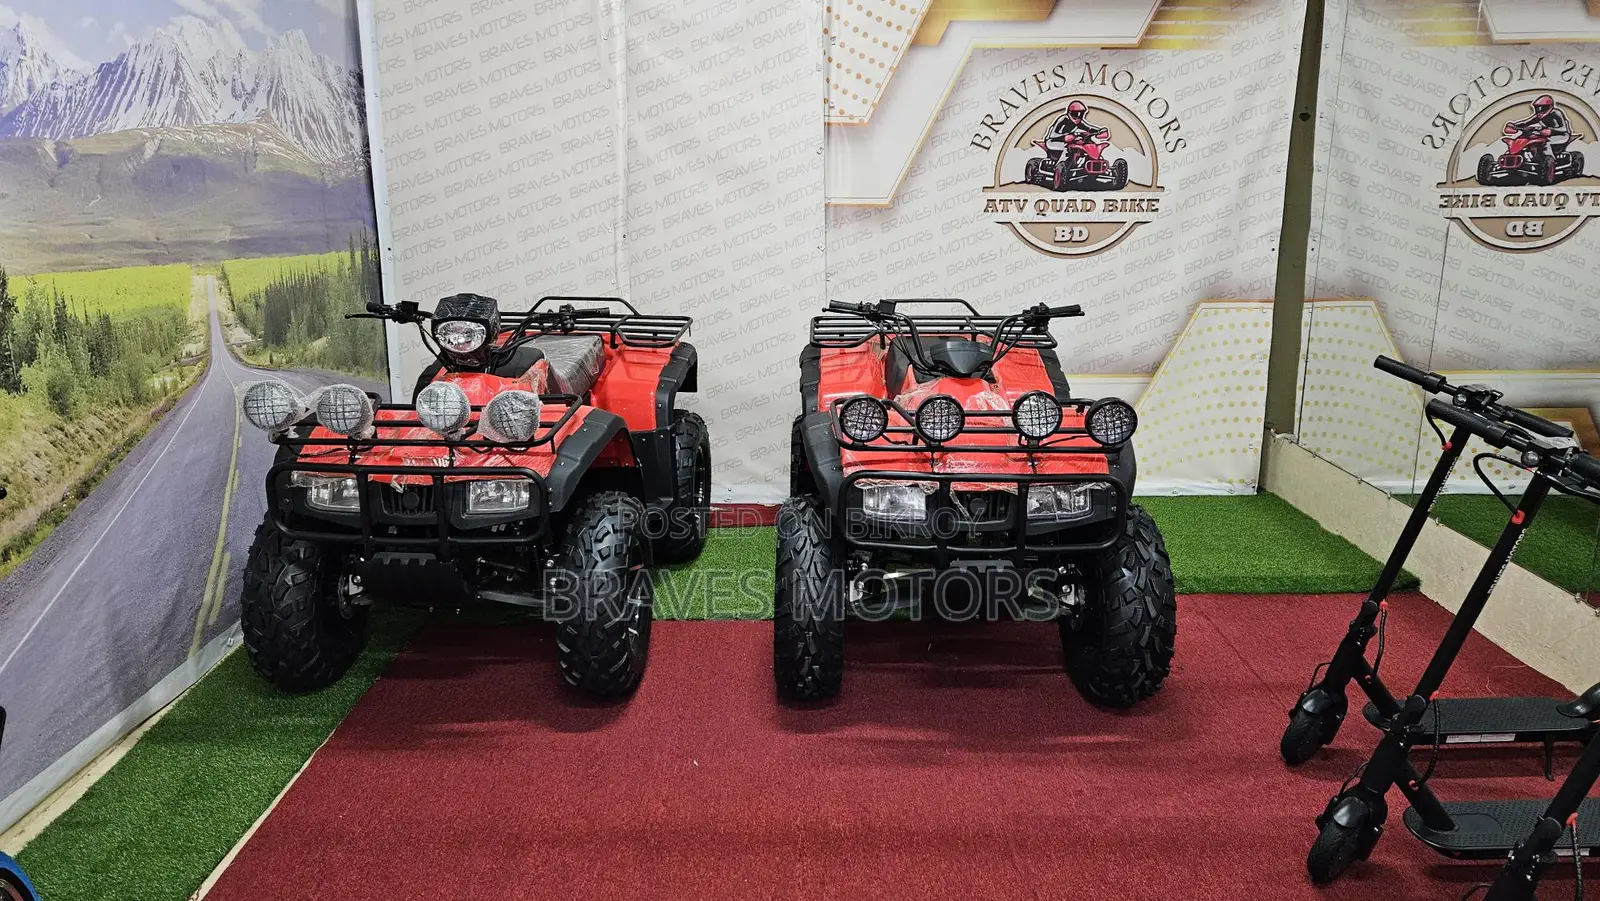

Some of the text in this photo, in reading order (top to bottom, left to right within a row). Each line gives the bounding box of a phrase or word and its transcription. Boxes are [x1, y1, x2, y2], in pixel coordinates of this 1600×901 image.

[405, 10, 462, 40] MOTORS
[413, 32, 468, 61] BRAVES
[470, 9, 527, 40] MOTORS
[479, 13, 593, 64] BRAVES MOTORS
[627, 1, 737, 51] BRAVES MOTORS
[690, 1, 801, 52] BRAVES MOTORS
[753, 19, 806, 49] BRAVES
[543, 35, 597, 63] BRAVES
[1231, 27, 1284, 57] BRAVES
[415, 57, 472, 86] MOTORS
[628, 47, 684, 76] MOTORS
[636, 45, 746, 98] BRAVES MOTORS
[699, 44, 809, 97] BRAVES MOTORS
[981, 51, 1038, 82] MOTORS
[1167, 51, 1224, 79] MOTORS
[1174, 51, 1285, 102] BRAVES MOTORS
[424, 58, 536, 108] BRAVES MOTORS
[488, 59, 601, 109] BRAVES MOTORS
[552, 80, 605, 109] BRAVES
[761, 65, 814, 95] BRAVES
[1234, 73, 1287, 101] BRAVES
[425, 104, 481, 134] MOTORS
[638, 92, 692, 122] MOTORS
[645, 90, 754, 140] BRAVES MOTORS
[707, 89, 816, 141] BRAVES MOTORS
[970, 62, 1187, 153] BRAVES MOTORS
[1231, 95, 1286, 127] MOTORS
[434, 103, 545, 154] BRAVES MOTORS
[499, 105, 609, 154] BRAVES MOTORS
[561, 126, 614, 154] BRAVES
[768, 111, 821, 139] BRAVES
[435, 149, 491, 180] MOTORS
[646, 137, 700, 166] MOTORS
[654, 158, 705, 186] BRAVES
[707, 135, 761, 165] MOTORS
[1172, 143, 1228, 170] MOTORS
[1179, 142, 1287, 190] BRAVES MOTORS
[444, 149, 553, 198] BRAVES MOTORS
[507, 172, 560, 200] BRAVES
[562, 149, 616, 180] MOTORS
[570, 172, 621, 199] BRAVES
[716, 157, 768, 186] BRAVES
[936, 164, 988, 192] BRAVES
[655, 181, 708, 211] MOTORS
[662, 178, 770, 230] BRAVES MOTORS
[983, 198, 1160, 216] ATV QUAD BIKE
[1176, 184, 1231, 213] MOTORS
[391, 194, 500, 242] BRAVES MOTORS
[453, 193, 562, 242] BRAVES MOTORS
[516, 216, 569, 243] BRAVES
[724, 201, 775, 229] BRAVES
[880, 207, 931, 233] BRAVES
[1181, 206, 1233, 233] BRAVES
[664, 224, 717, 253] MOTORS
[671, 222, 777, 272] BRAVES MOTORS
[880, 229, 933, 259] MOTORS
[1053, 226, 1090, 242] BD
[1120, 228, 1174, 256] MOTORS
[393, 237, 446, 264] MOTORS
[402, 238, 508, 286] BRAVES MOTORS
[463, 237, 570, 283] BRAVES MOTORS
[732, 245, 783, 273] BRAVES
[886, 228, 993, 275] BRAVES MOTORS
[946, 250, 997, 277] BRAVES
[1124, 227, 1231, 275] BRAVES MOTORS
[1184, 250, 1234, 275] BRAVES
[525, 259, 576, 286] BRAVES
[672, 267, 725, 297] MOTORS
[885, 271, 939, 299] MOTORS
[943, 270, 998, 298] MOTORS
[1003, 272, 1059, 300] MOTORS
[1063, 270, 1117, 301] MOTORS
[1123, 270, 1176, 297] MOTORS
[680, 265, 784, 314] BRAVES MOTORS
[740, 288, 790, 314] BRAVES
[1128, 290, 1178, 315] BRAVES
[1181, 268, 1233, 296] MOTORS
[739, 307, 792, 337] MOTORS
[1126, 311, 1179, 338] MOTORS
[743, 331, 796, 359] MOTORS
[706, 374, 755, 400] BRAVES
[721, 392, 771, 421] BRAVES
[736, 413, 785, 441] BRAVES
